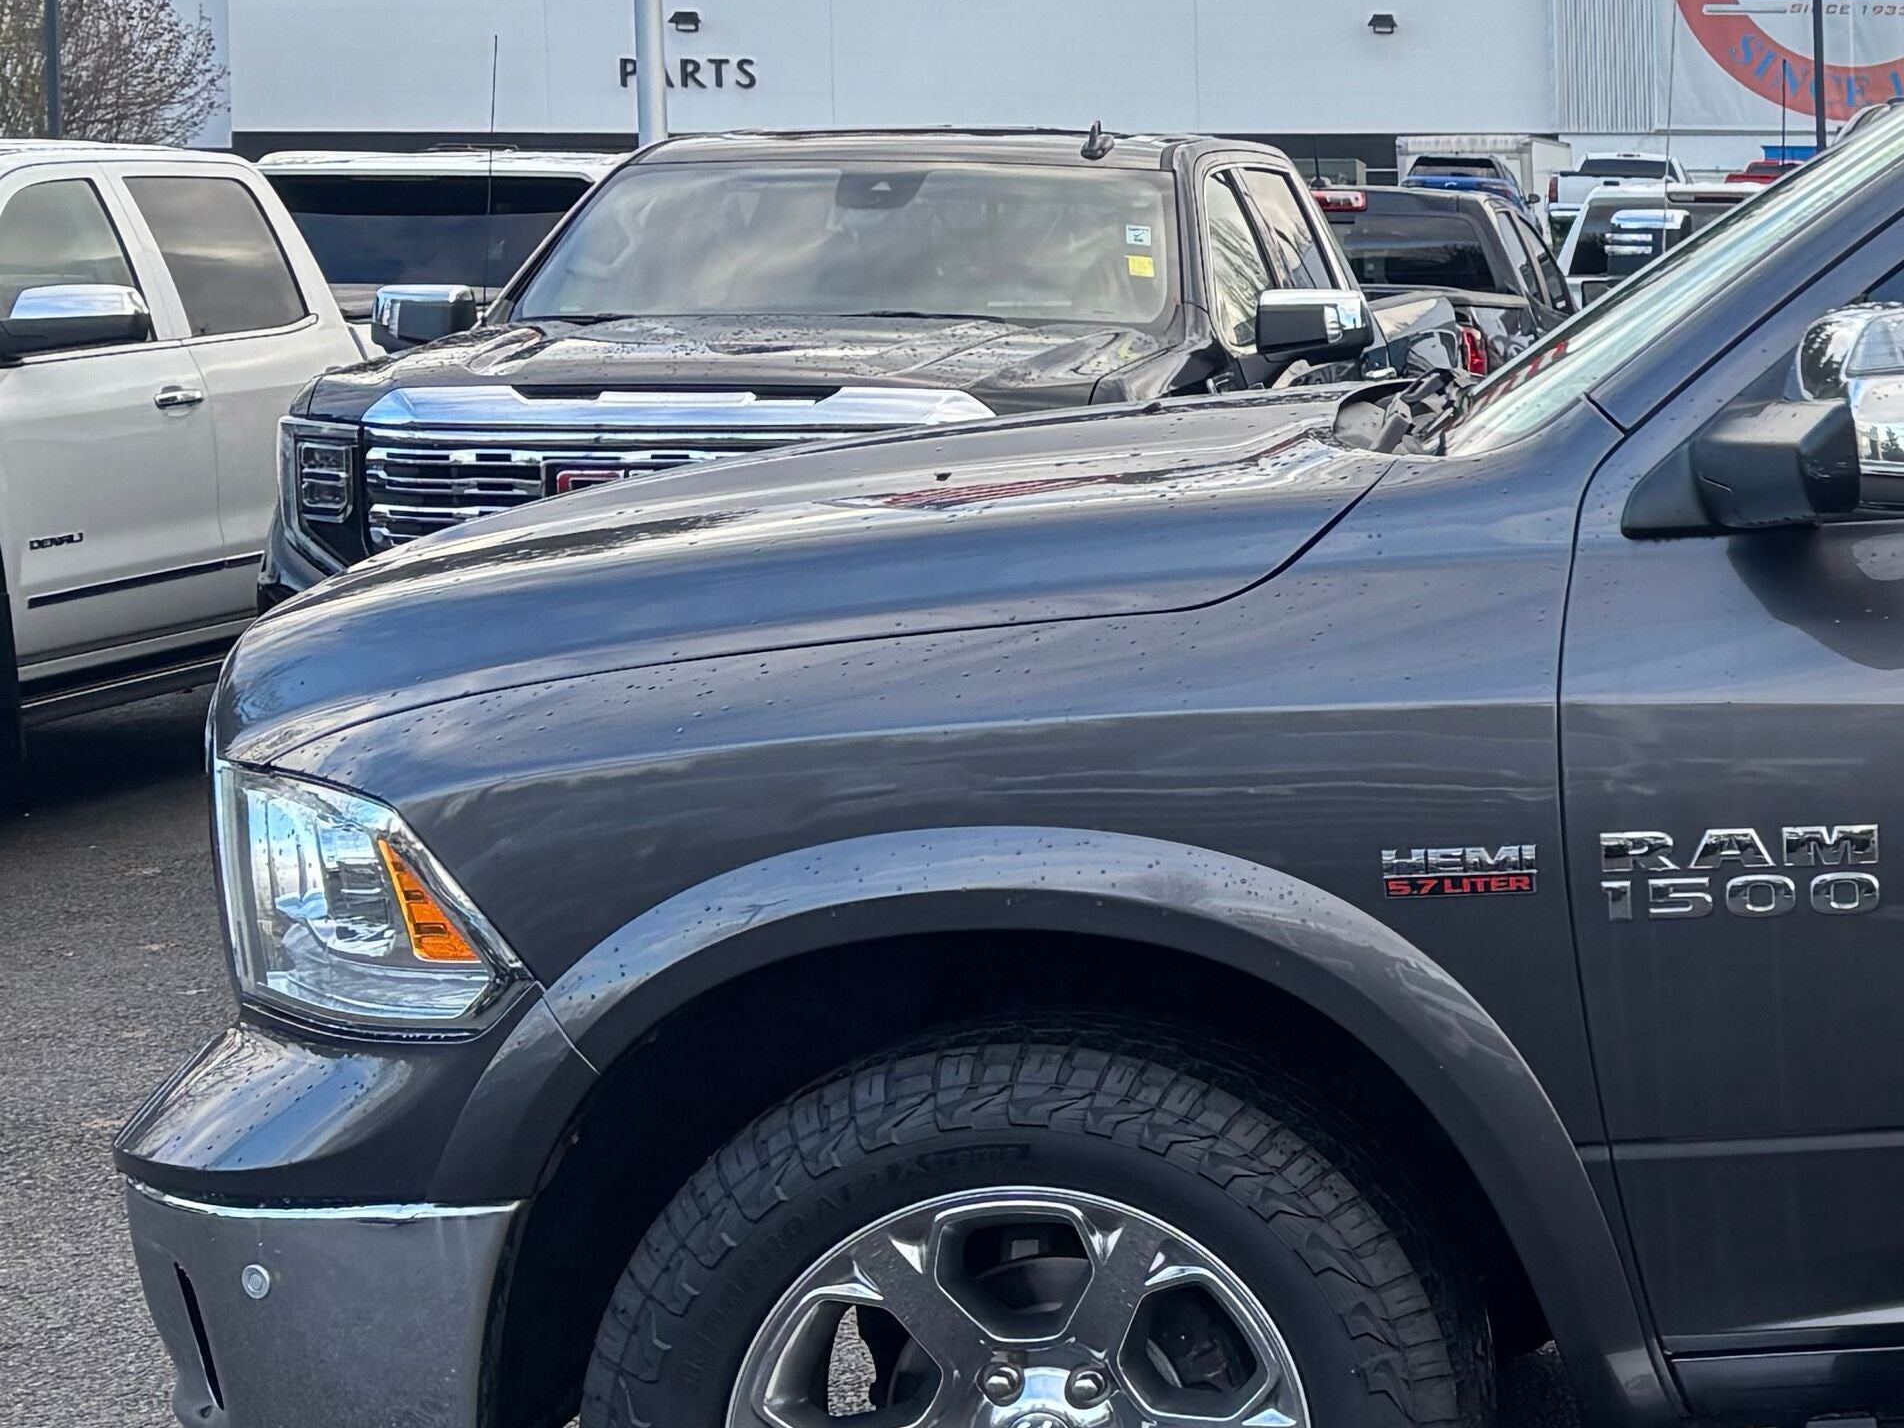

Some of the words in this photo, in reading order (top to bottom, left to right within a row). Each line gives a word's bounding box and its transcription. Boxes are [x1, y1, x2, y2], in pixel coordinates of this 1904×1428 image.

[1790, 3, 1850, 15] SICE
[619, 58, 757, 89] PRTS
[1382, 844, 1536, 875] HEMI
[1599, 824, 1879, 872] RAM
[1388, 879, 1437, 895] 5.7
[1443, 875, 1530, 894] LITER
[1601, 873, 1879, 920] 1500
